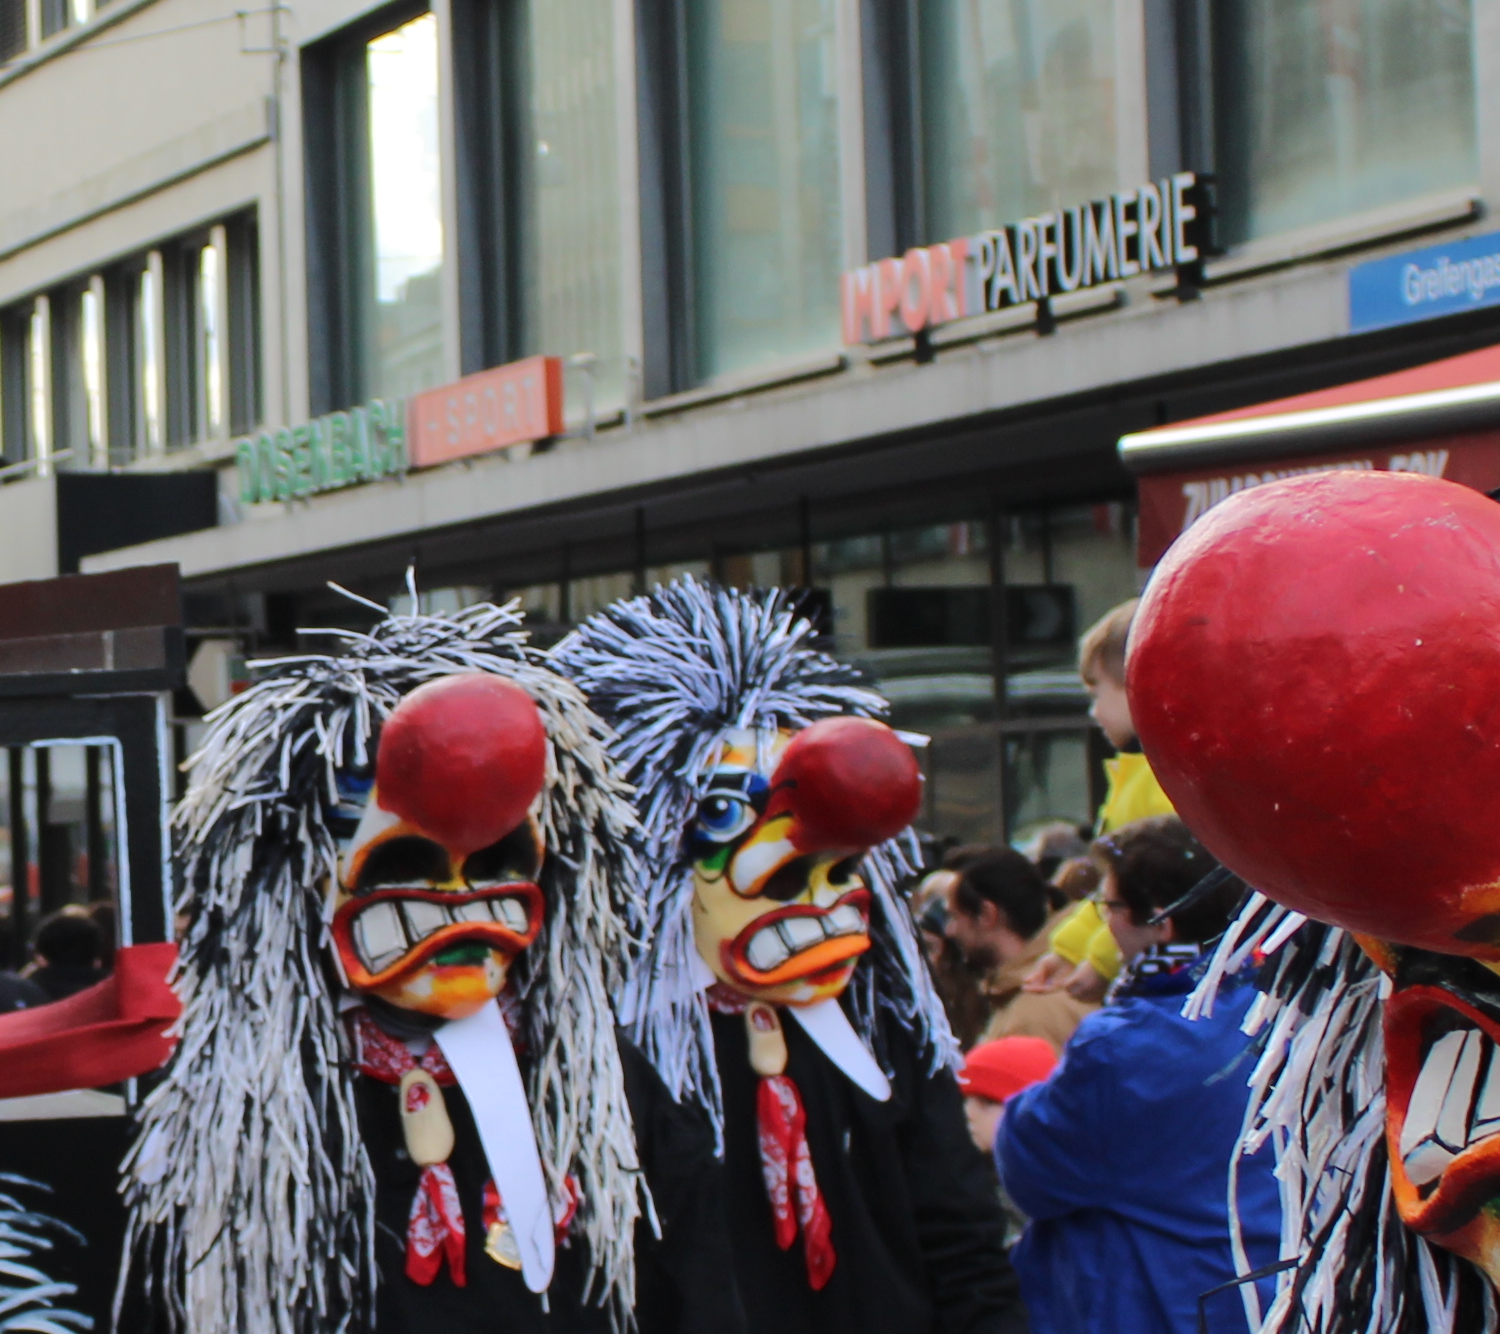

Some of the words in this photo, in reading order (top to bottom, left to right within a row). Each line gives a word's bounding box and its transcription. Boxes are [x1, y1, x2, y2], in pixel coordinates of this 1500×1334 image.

[841, 237, 971, 345] IMPORT
[977, 170, 1199, 314] PARFUMERIE
[236, 398, 406, 505] DOSENBACH
